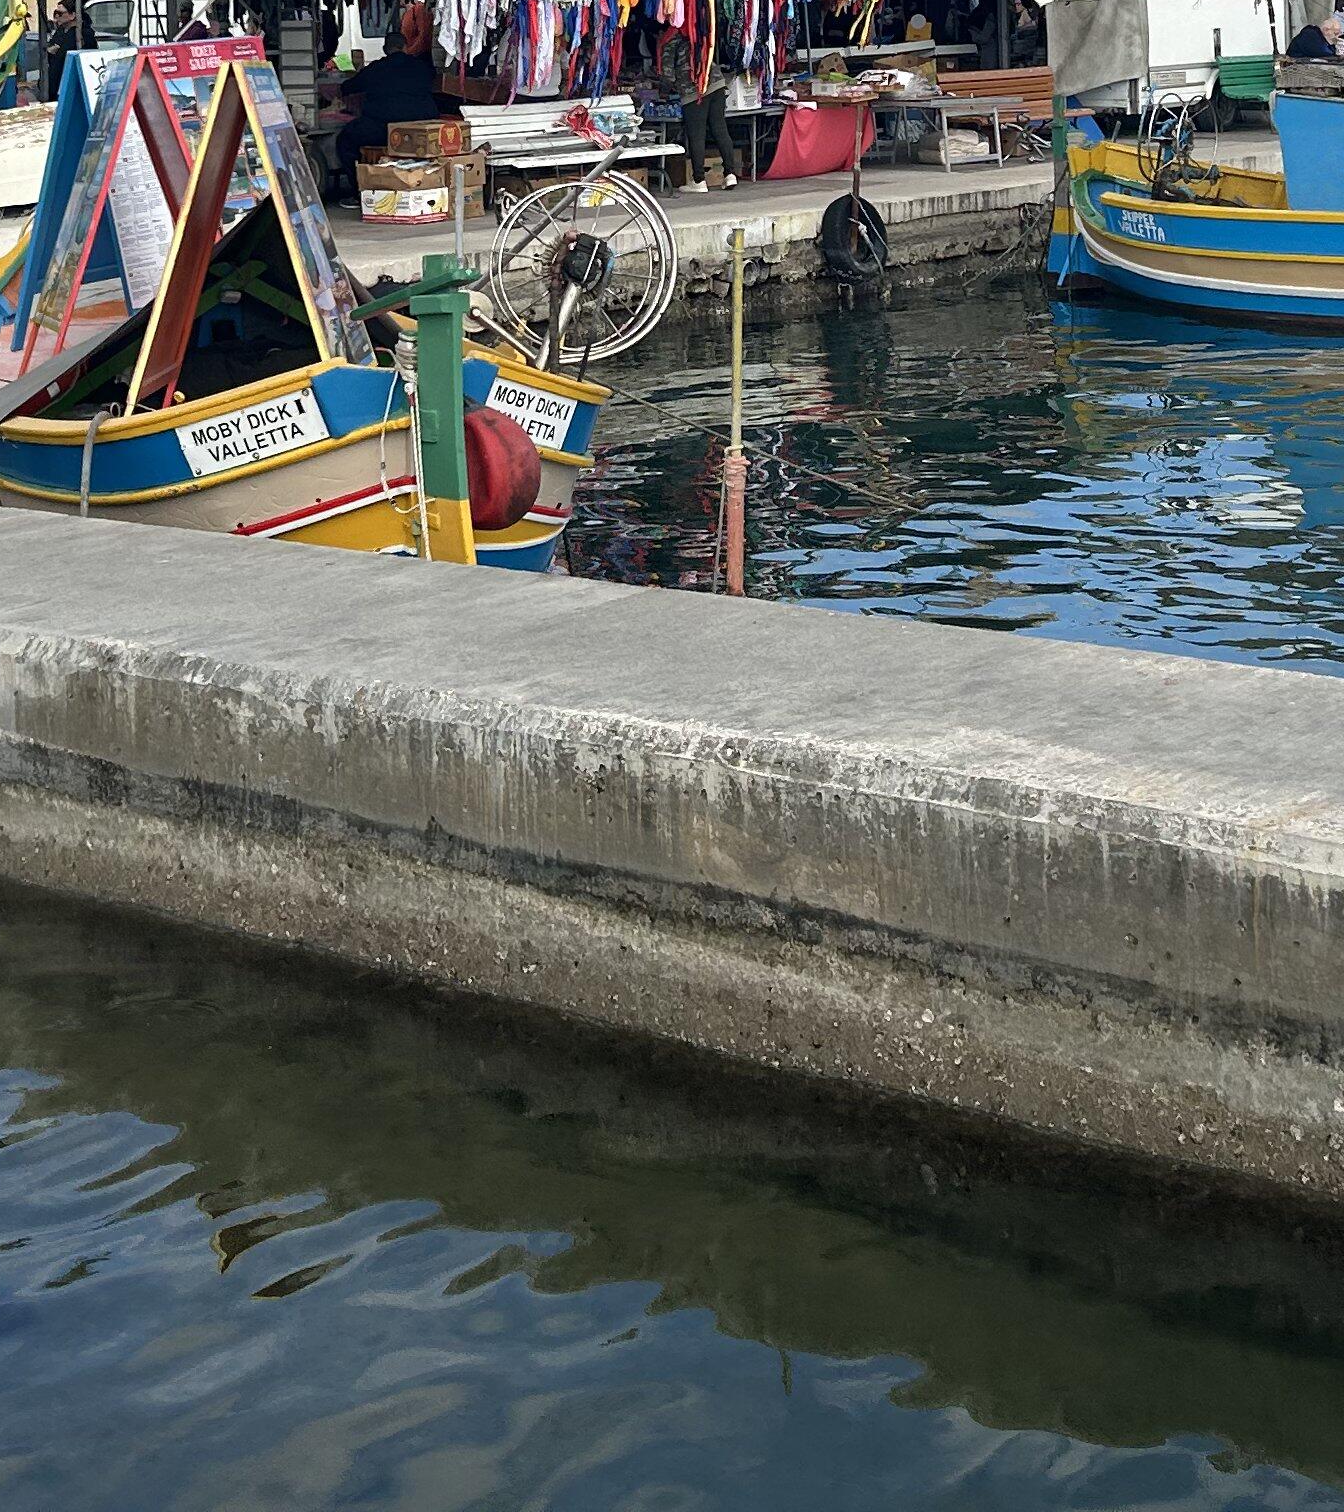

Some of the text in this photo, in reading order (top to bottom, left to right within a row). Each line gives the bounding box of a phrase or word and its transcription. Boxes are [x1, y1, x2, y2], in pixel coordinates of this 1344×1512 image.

[1117, 219, 1166, 242] VALLETTA
[493, 385, 536, 411] MOBY
[192, 417, 242, 447] MOBY
[246, 402, 293, 430] DICK
[207, 422, 305, 463] VALLETTA
